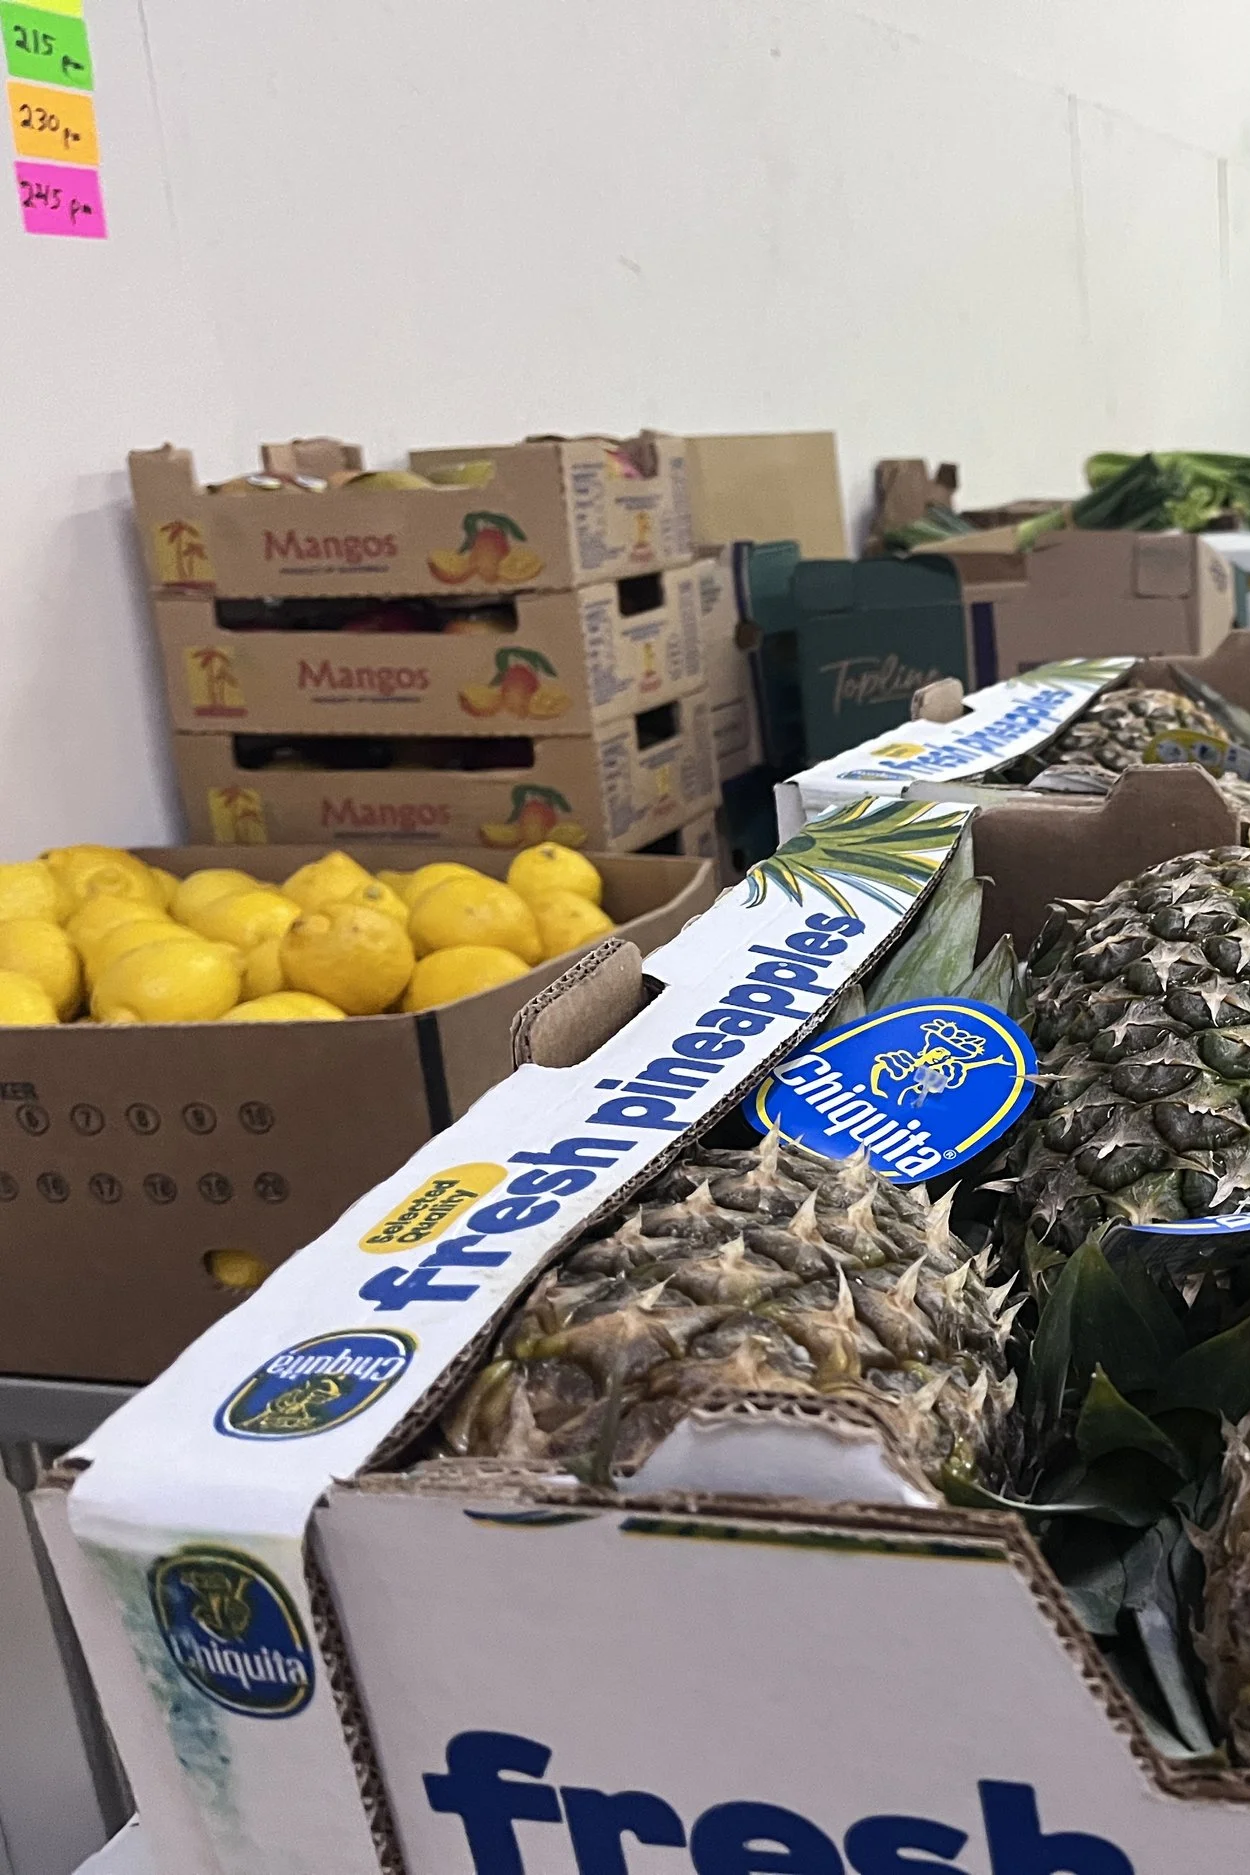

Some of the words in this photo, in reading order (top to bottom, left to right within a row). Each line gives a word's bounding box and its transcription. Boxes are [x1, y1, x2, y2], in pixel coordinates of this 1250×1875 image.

[14, 25, 56, 55] 215
[20, 104, 60, 132] 230
[20, 181, 62, 210] 245
[263, 529, 398, 563] Mangos
[298, 660, 430, 696] Mangos
[321, 796, 450, 832] Mangos
[359, 1137, 638, 1312] fresh
[586, 912, 866, 1132] pineapples
[773, 1053, 942, 1178] Chiquita
[366, 1180, 461, 1244] Selected
[397, 1189, 479, 1243] Quality
[267, 1348, 406, 1382] Chiquita
[170, 1628, 309, 1691] Chiquita
